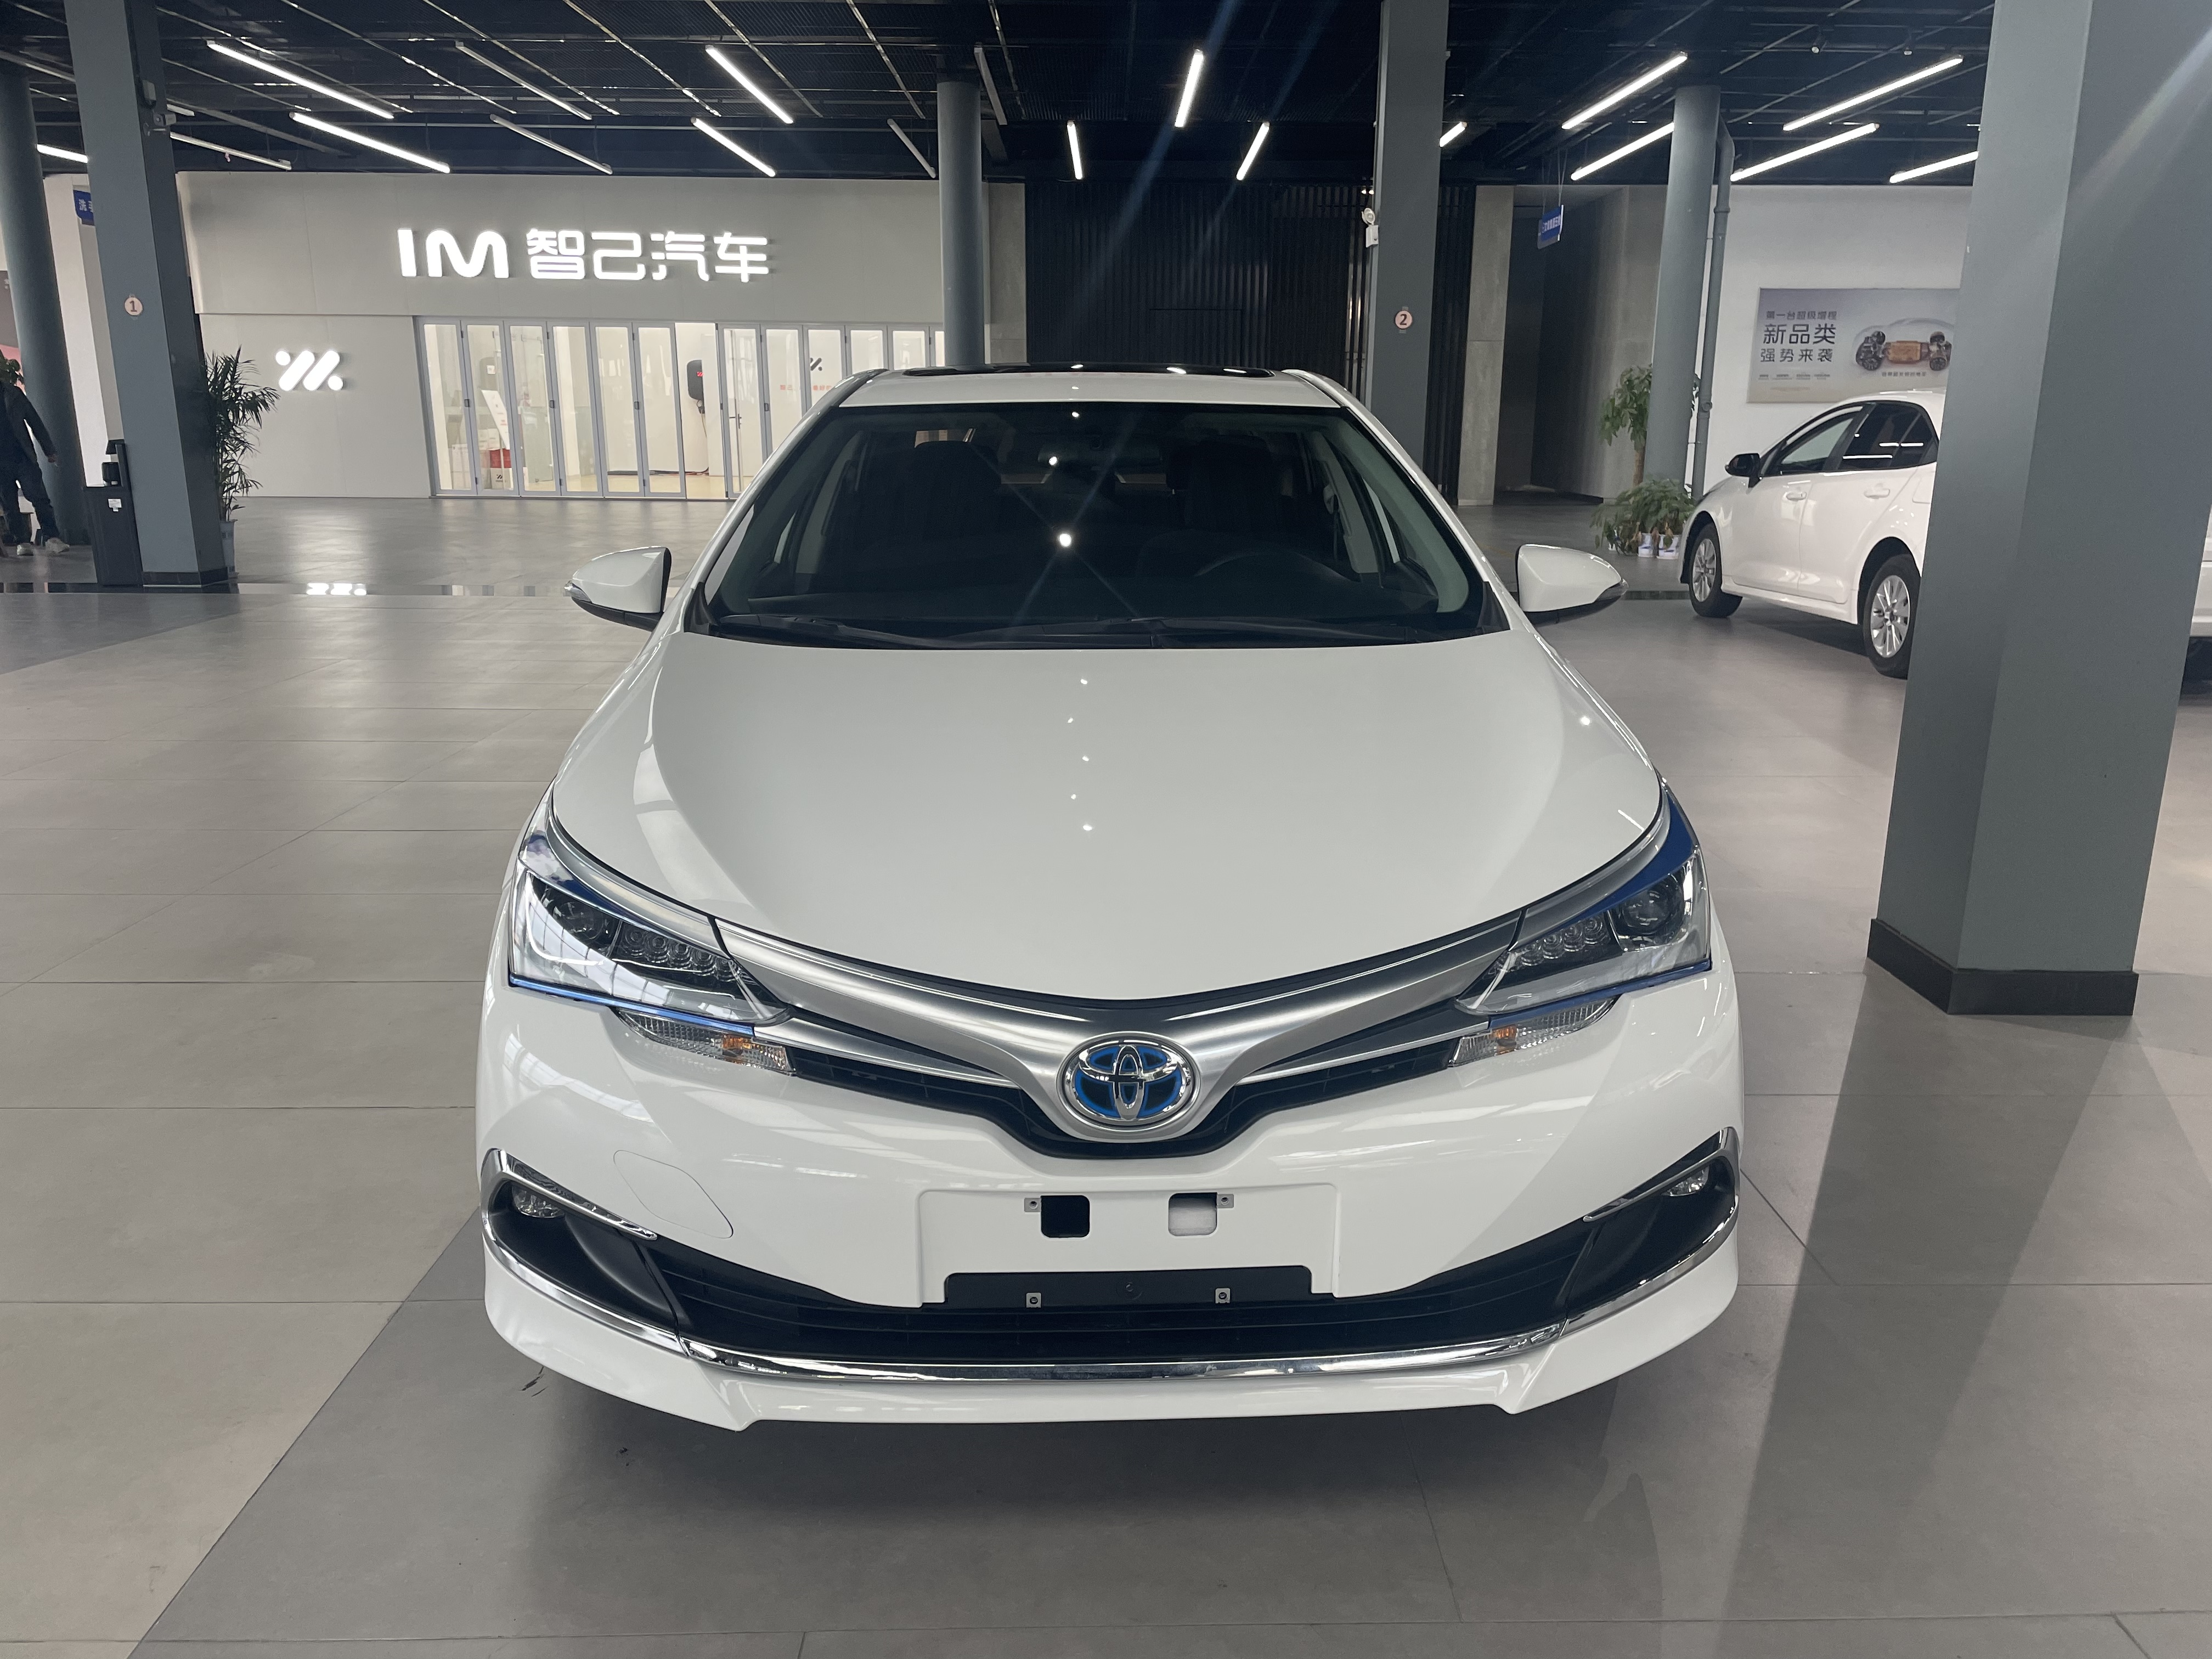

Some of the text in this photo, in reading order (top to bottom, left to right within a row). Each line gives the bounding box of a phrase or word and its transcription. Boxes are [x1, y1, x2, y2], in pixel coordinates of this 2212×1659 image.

[398, 228, 769, 283] IM 智己汽车
[129, 300, 138, 312] 1
[1400, 313, 1407, 326] 2
[1763, 323, 1836, 345] 新品类
[1760, 348, 1833, 363] 强势来袭
